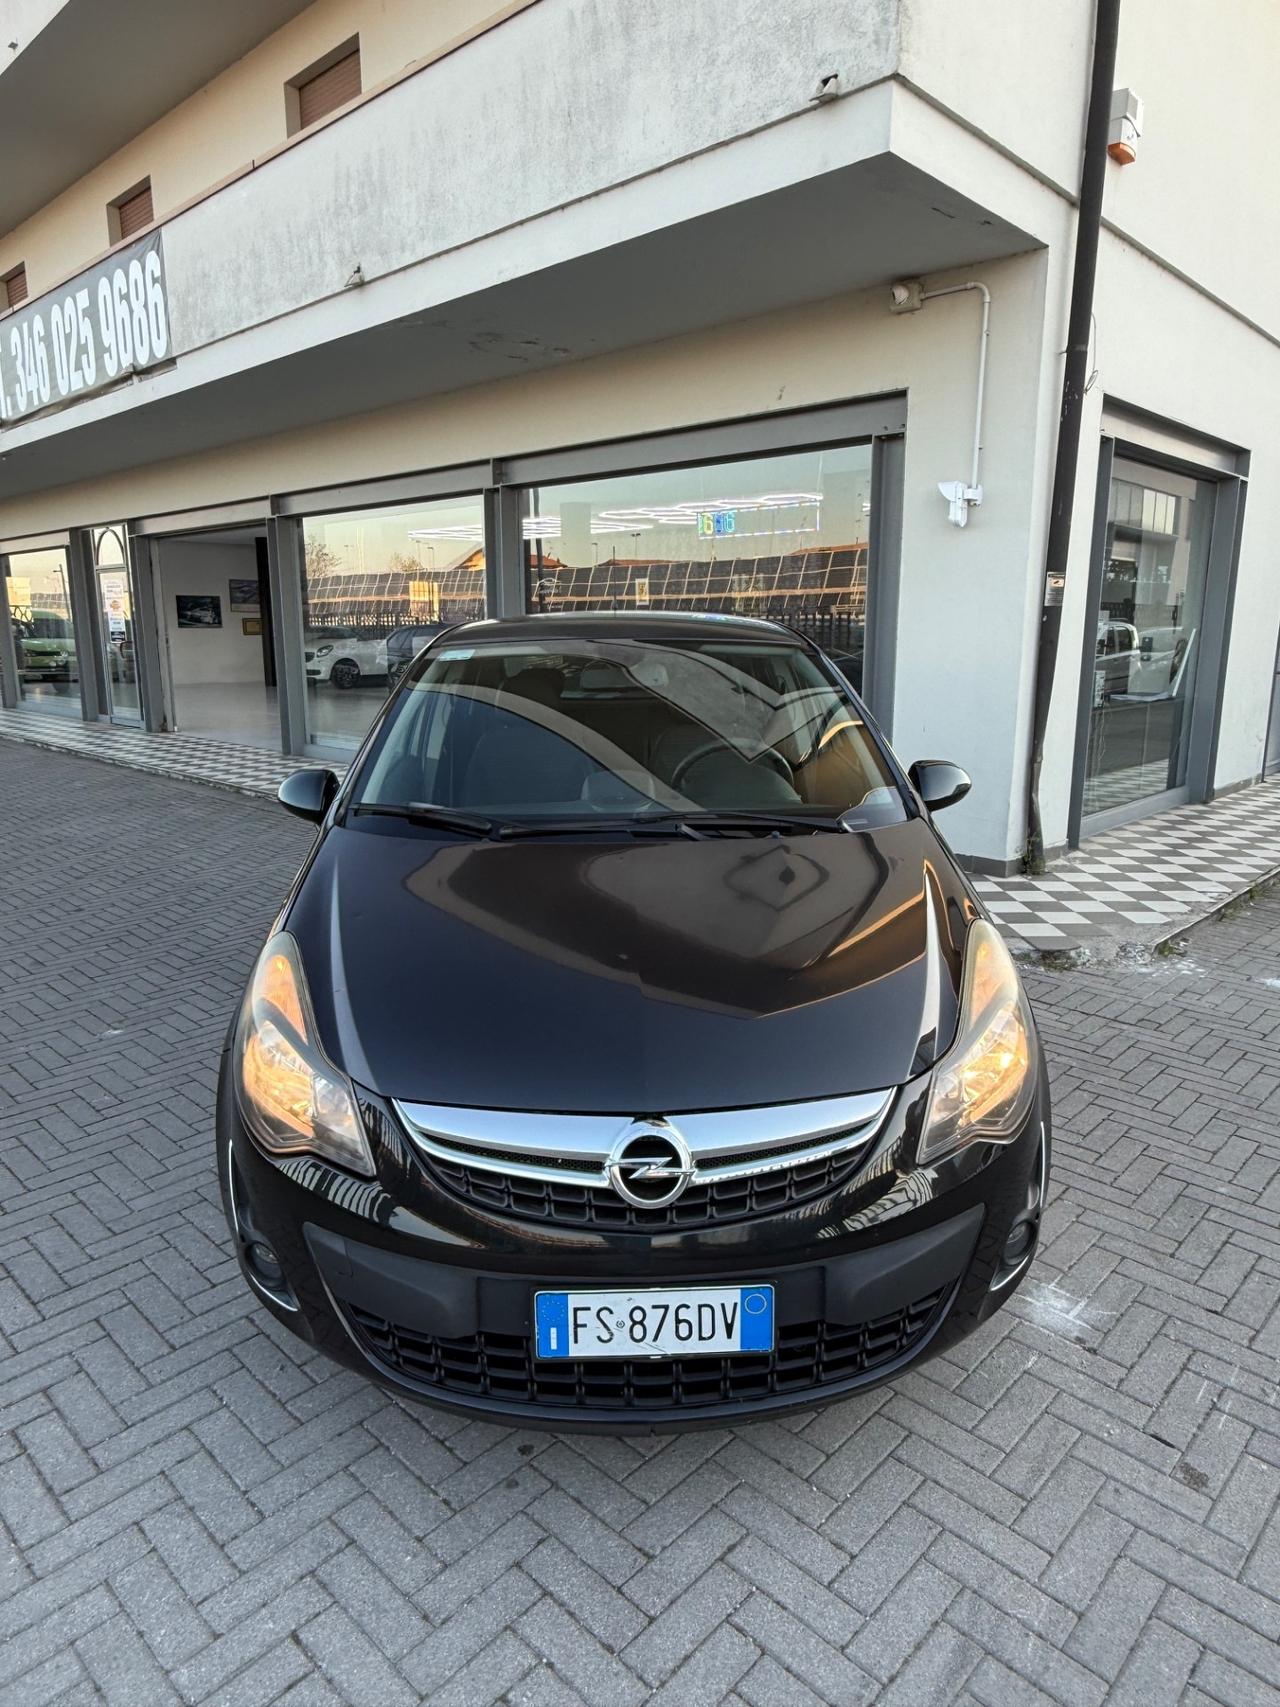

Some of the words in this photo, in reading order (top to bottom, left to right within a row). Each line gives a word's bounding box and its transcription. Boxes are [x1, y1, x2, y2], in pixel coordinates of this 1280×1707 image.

[11, 314, 51, 412] 346
[50, 288, 96, 396] 025
[98, 250, 168, 378] 9686
[572, 1306, 614, 1344] FS
[628, 1302, 738, 1344] 876DV
